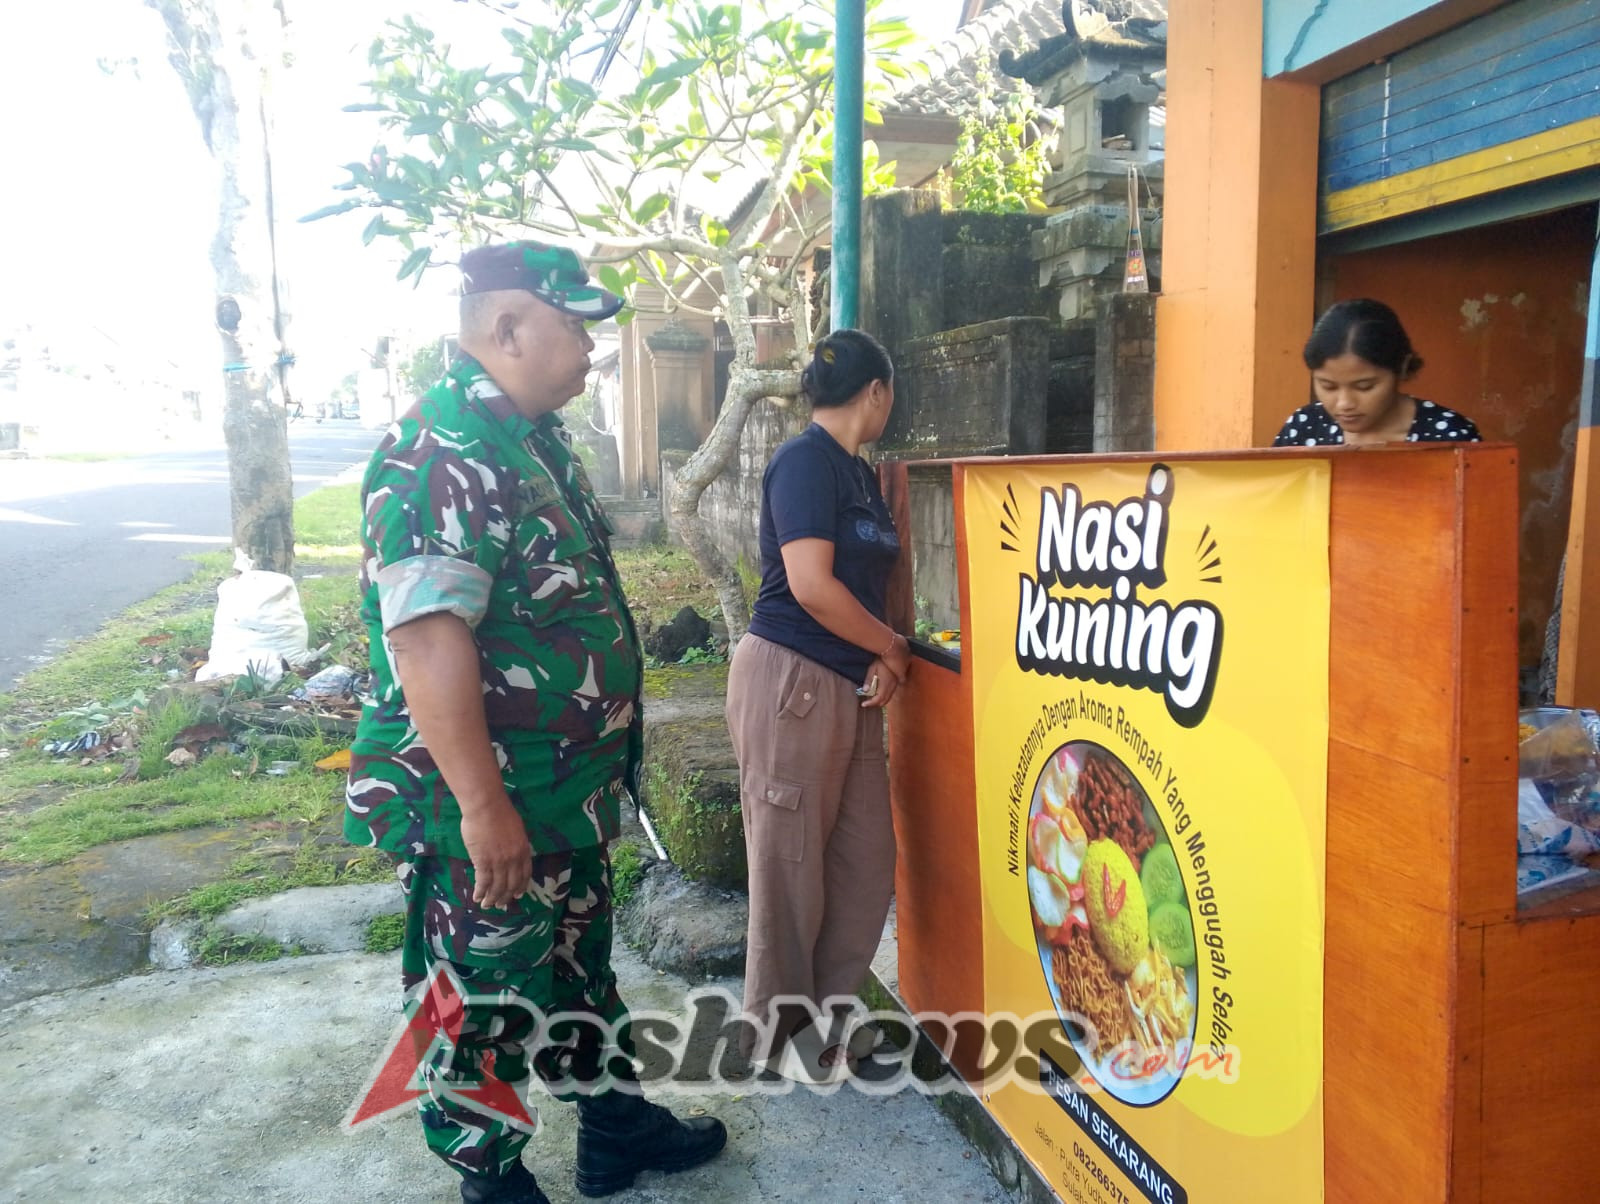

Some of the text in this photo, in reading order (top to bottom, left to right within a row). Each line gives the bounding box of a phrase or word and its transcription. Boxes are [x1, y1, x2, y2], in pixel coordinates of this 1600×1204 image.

[1038, 466, 1166, 574] Nasi
[1017, 575, 1218, 711] Kuning
[1008, 689, 1234, 1062] Nikmati Kelezatannya Dengan Aroma Rempah Yang Menggugah Selera
[1034, 1121, 1055, 1152] Jalan
[1059, 1148, 1080, 1182] Putra
[1047, 1068, 1174, 1204] PESAN SEKARANG
